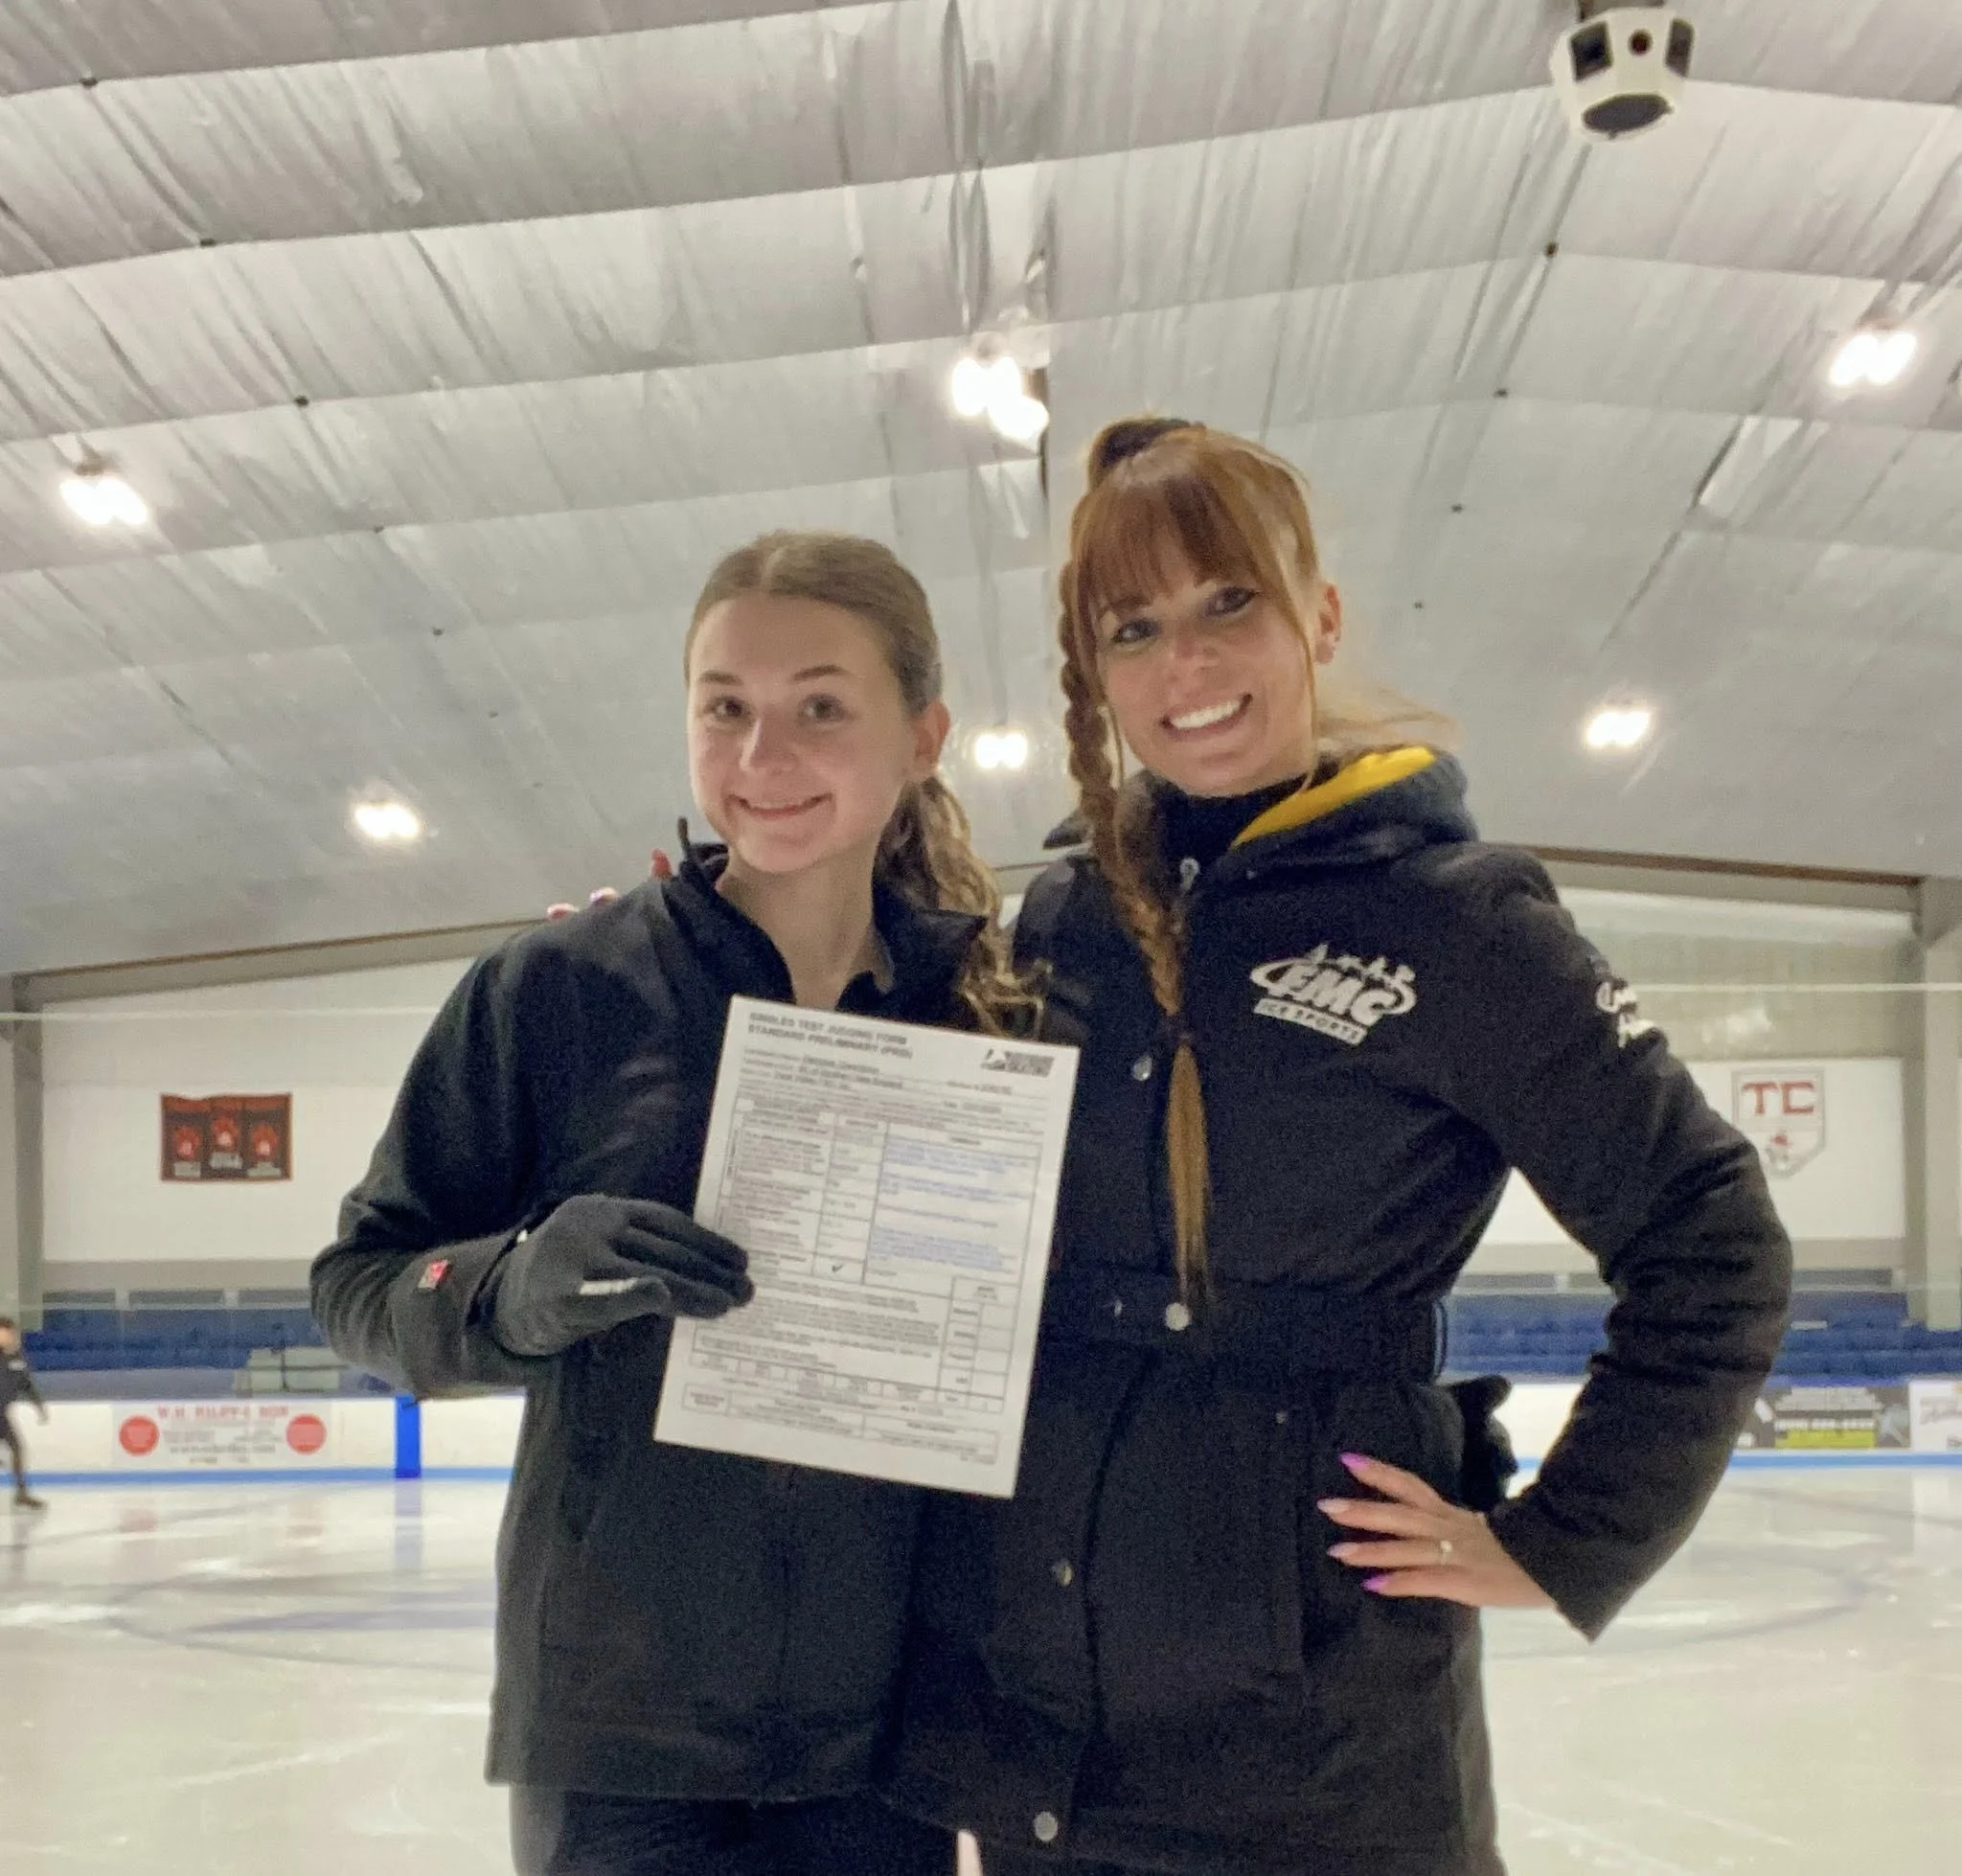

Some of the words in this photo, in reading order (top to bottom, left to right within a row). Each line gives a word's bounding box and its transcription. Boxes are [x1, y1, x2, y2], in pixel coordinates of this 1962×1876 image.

[1268, 965, 1399, 1026] EMC
[1295, 1008, 1359, 1040] SPORTS
[1742, 1081, 1814, 1115] TC
